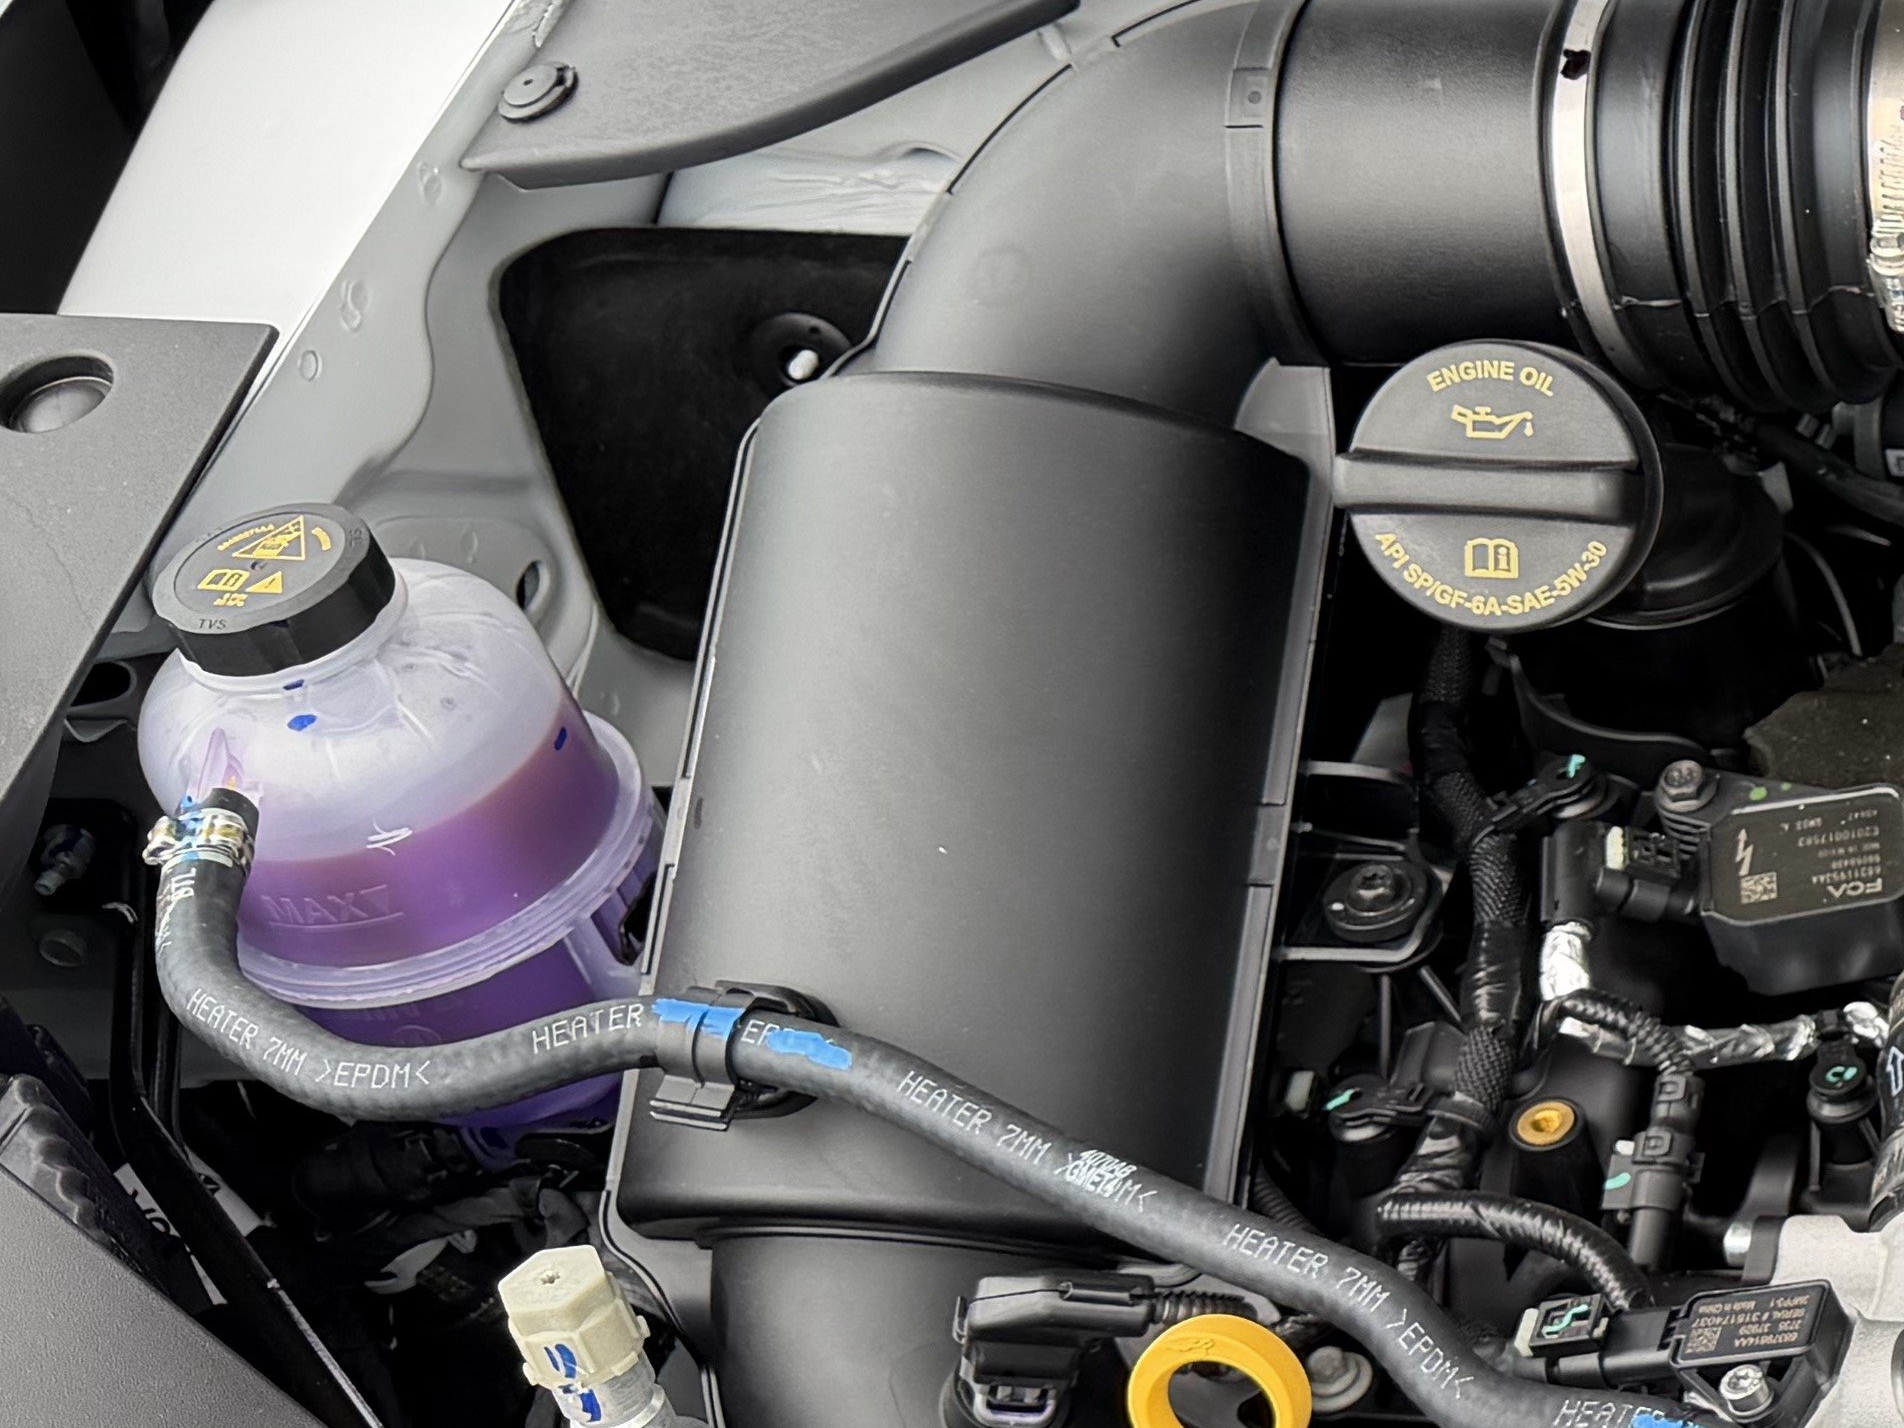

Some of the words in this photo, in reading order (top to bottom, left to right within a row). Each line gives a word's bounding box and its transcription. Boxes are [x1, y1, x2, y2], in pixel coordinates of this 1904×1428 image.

[1427, 360, 1515, 394] ENGINE
[1519, 366, 1556, 397] OIL
[1376, 531, 1410, 570] API
[259, 891, 368, 924] MAX
[1826, 877, 1883, 899] FCA
[187, 988, 258, 1049] HEATER
[263, 1037, 307, 1076] 7MM
[316, 1059, 430, 1089] >EPDM<
[532, 1002, 646, 1054] HEATER
[897, 1071, 992, 1135] HEATER
[997, 1123, 1052, 1165] 7MM
[1223, 1223, 1329, 1279] HEATER
[1335, 1266, 1391, 1313] 7MM
[1385, 1308, 1475, 1400] >EPDM<
